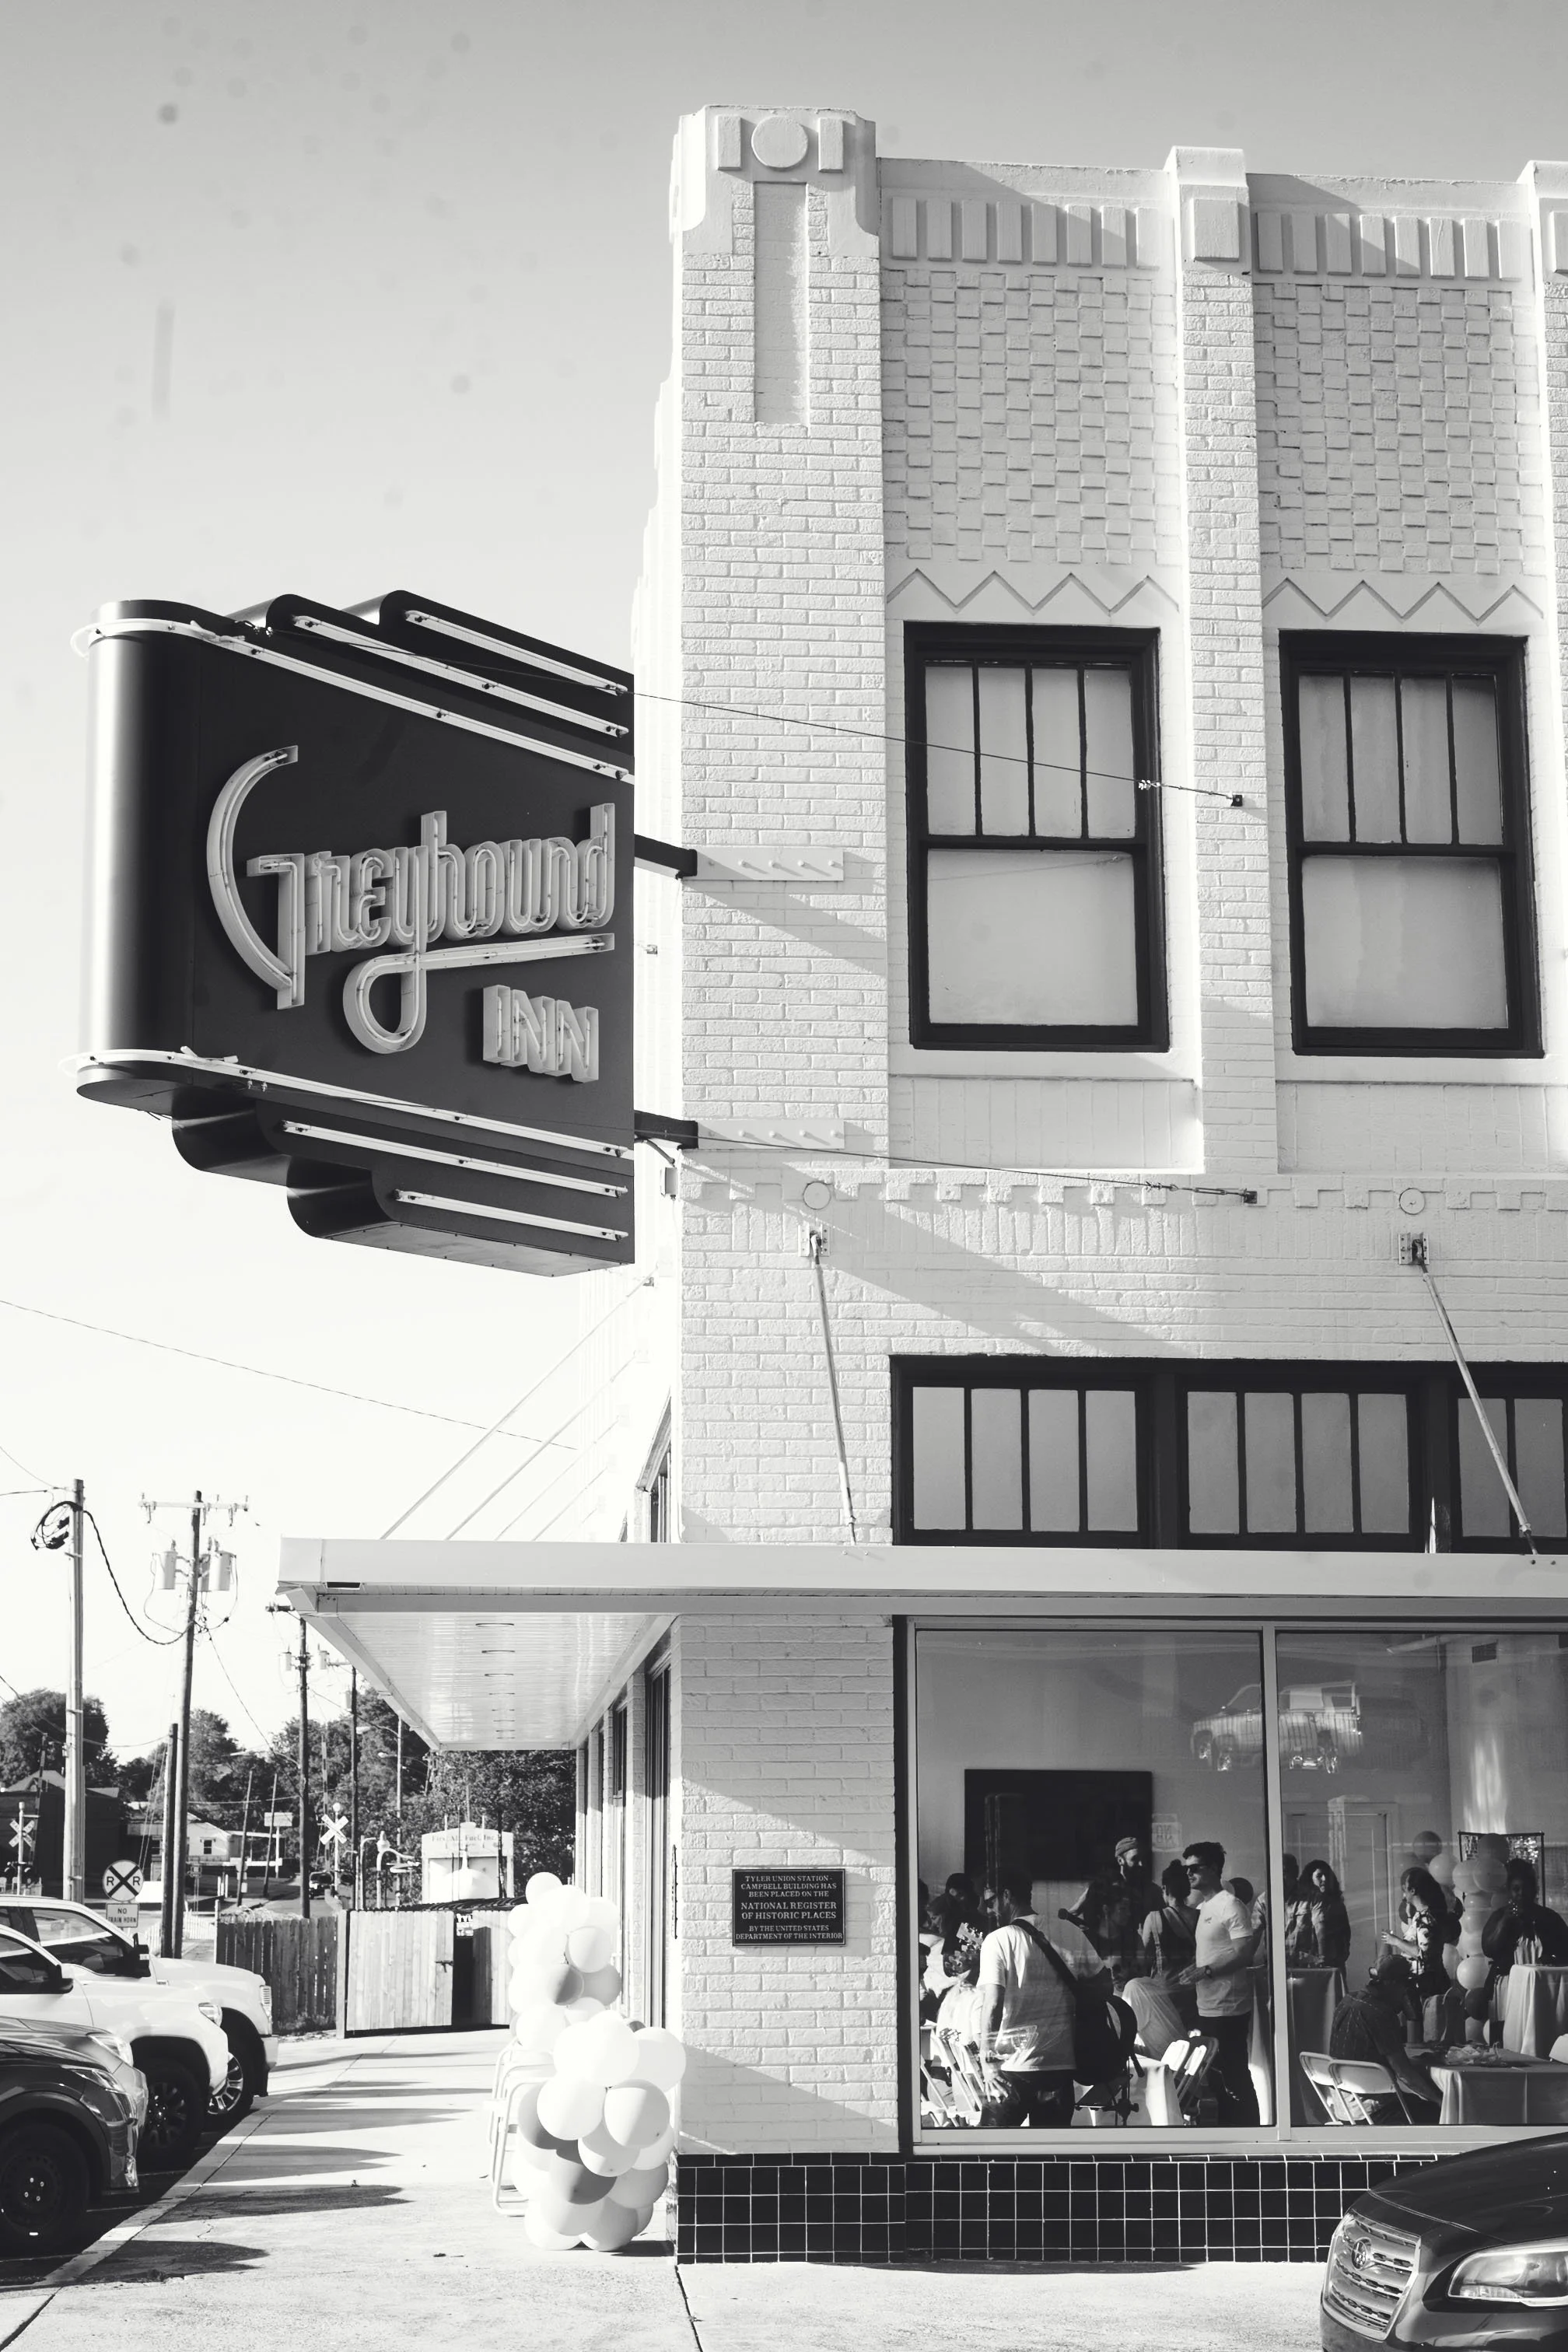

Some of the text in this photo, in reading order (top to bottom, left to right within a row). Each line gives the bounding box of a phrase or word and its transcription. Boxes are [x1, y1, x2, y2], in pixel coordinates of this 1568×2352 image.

[207, 745, 615, 1055] Greyhound
[483, 984, 599, 1083] INN
[107, 1876, 140, 1886] R R
